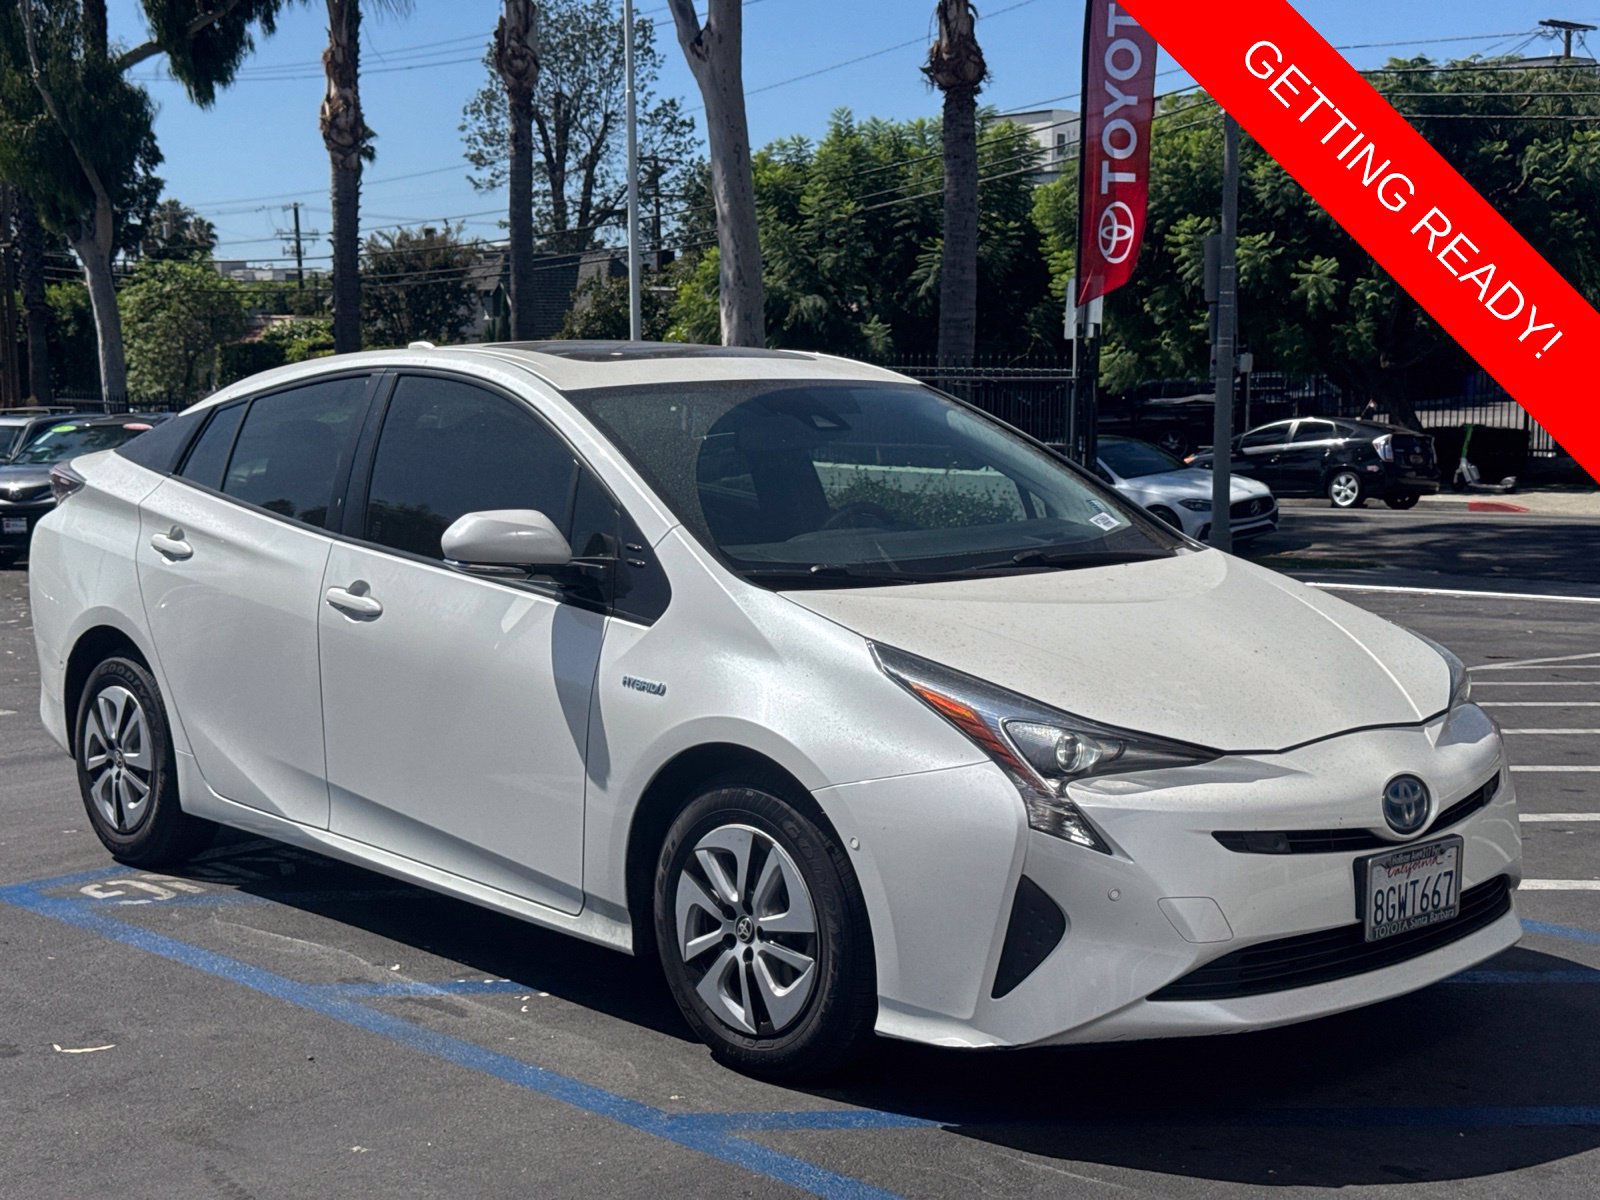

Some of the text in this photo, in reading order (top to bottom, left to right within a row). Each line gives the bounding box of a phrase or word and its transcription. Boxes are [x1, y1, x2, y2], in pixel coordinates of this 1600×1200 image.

[1387, 856, 1444, 879] California
[1374, 870, 1454, 925] 8GWT667
[1374, 908, 1455, 939] TOYOTA Santa Barbara
